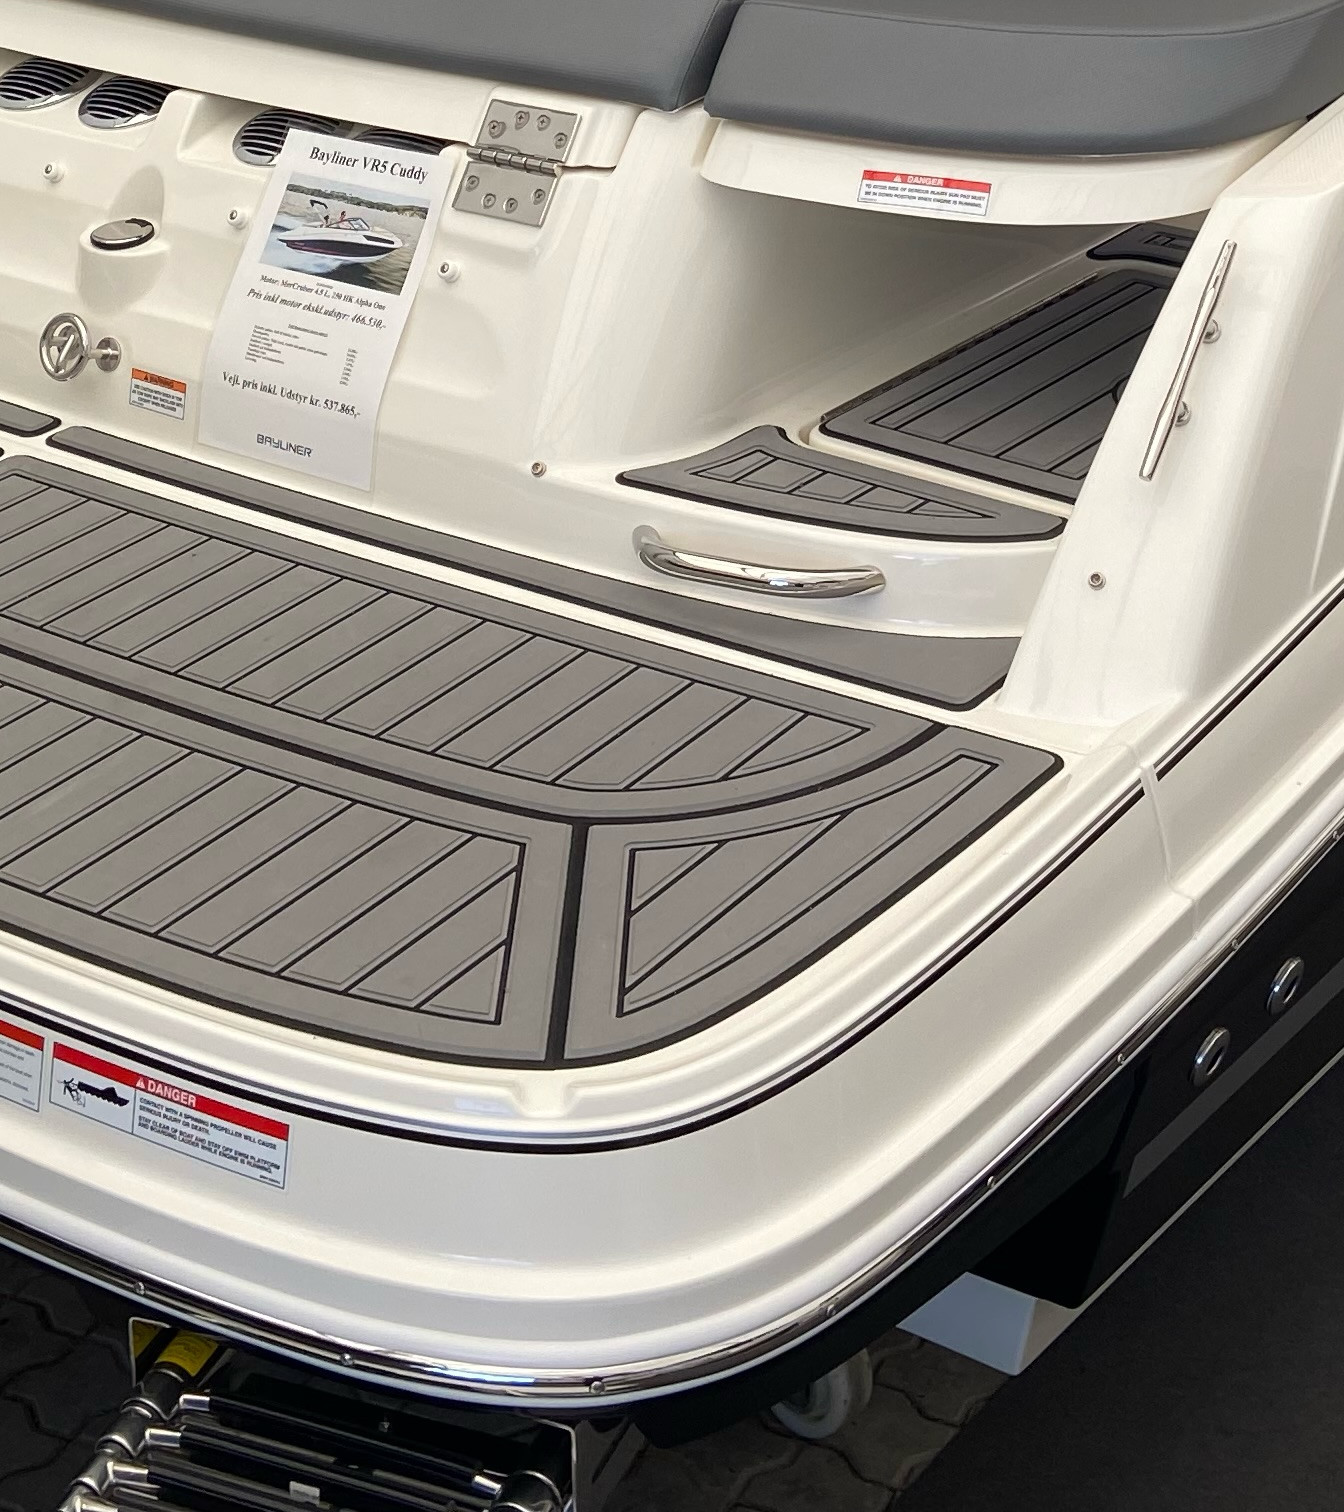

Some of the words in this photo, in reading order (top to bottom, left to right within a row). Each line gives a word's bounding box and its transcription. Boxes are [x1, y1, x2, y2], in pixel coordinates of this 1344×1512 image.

[310, 146, 359, 169] Bayliner
[363, 156, 388, 174] VR5
[390, 162, 429, 185] Cuddy
[907, 175, 944, 186] DANGER
[279, 298, 303, 310] motor
[241, 378, 258, 390] pris
[280, 386, 309, 404] Udstyr
[256, 433, 314, 458] BAYLINER
[147, 1079, 197, 1108] DANGER
